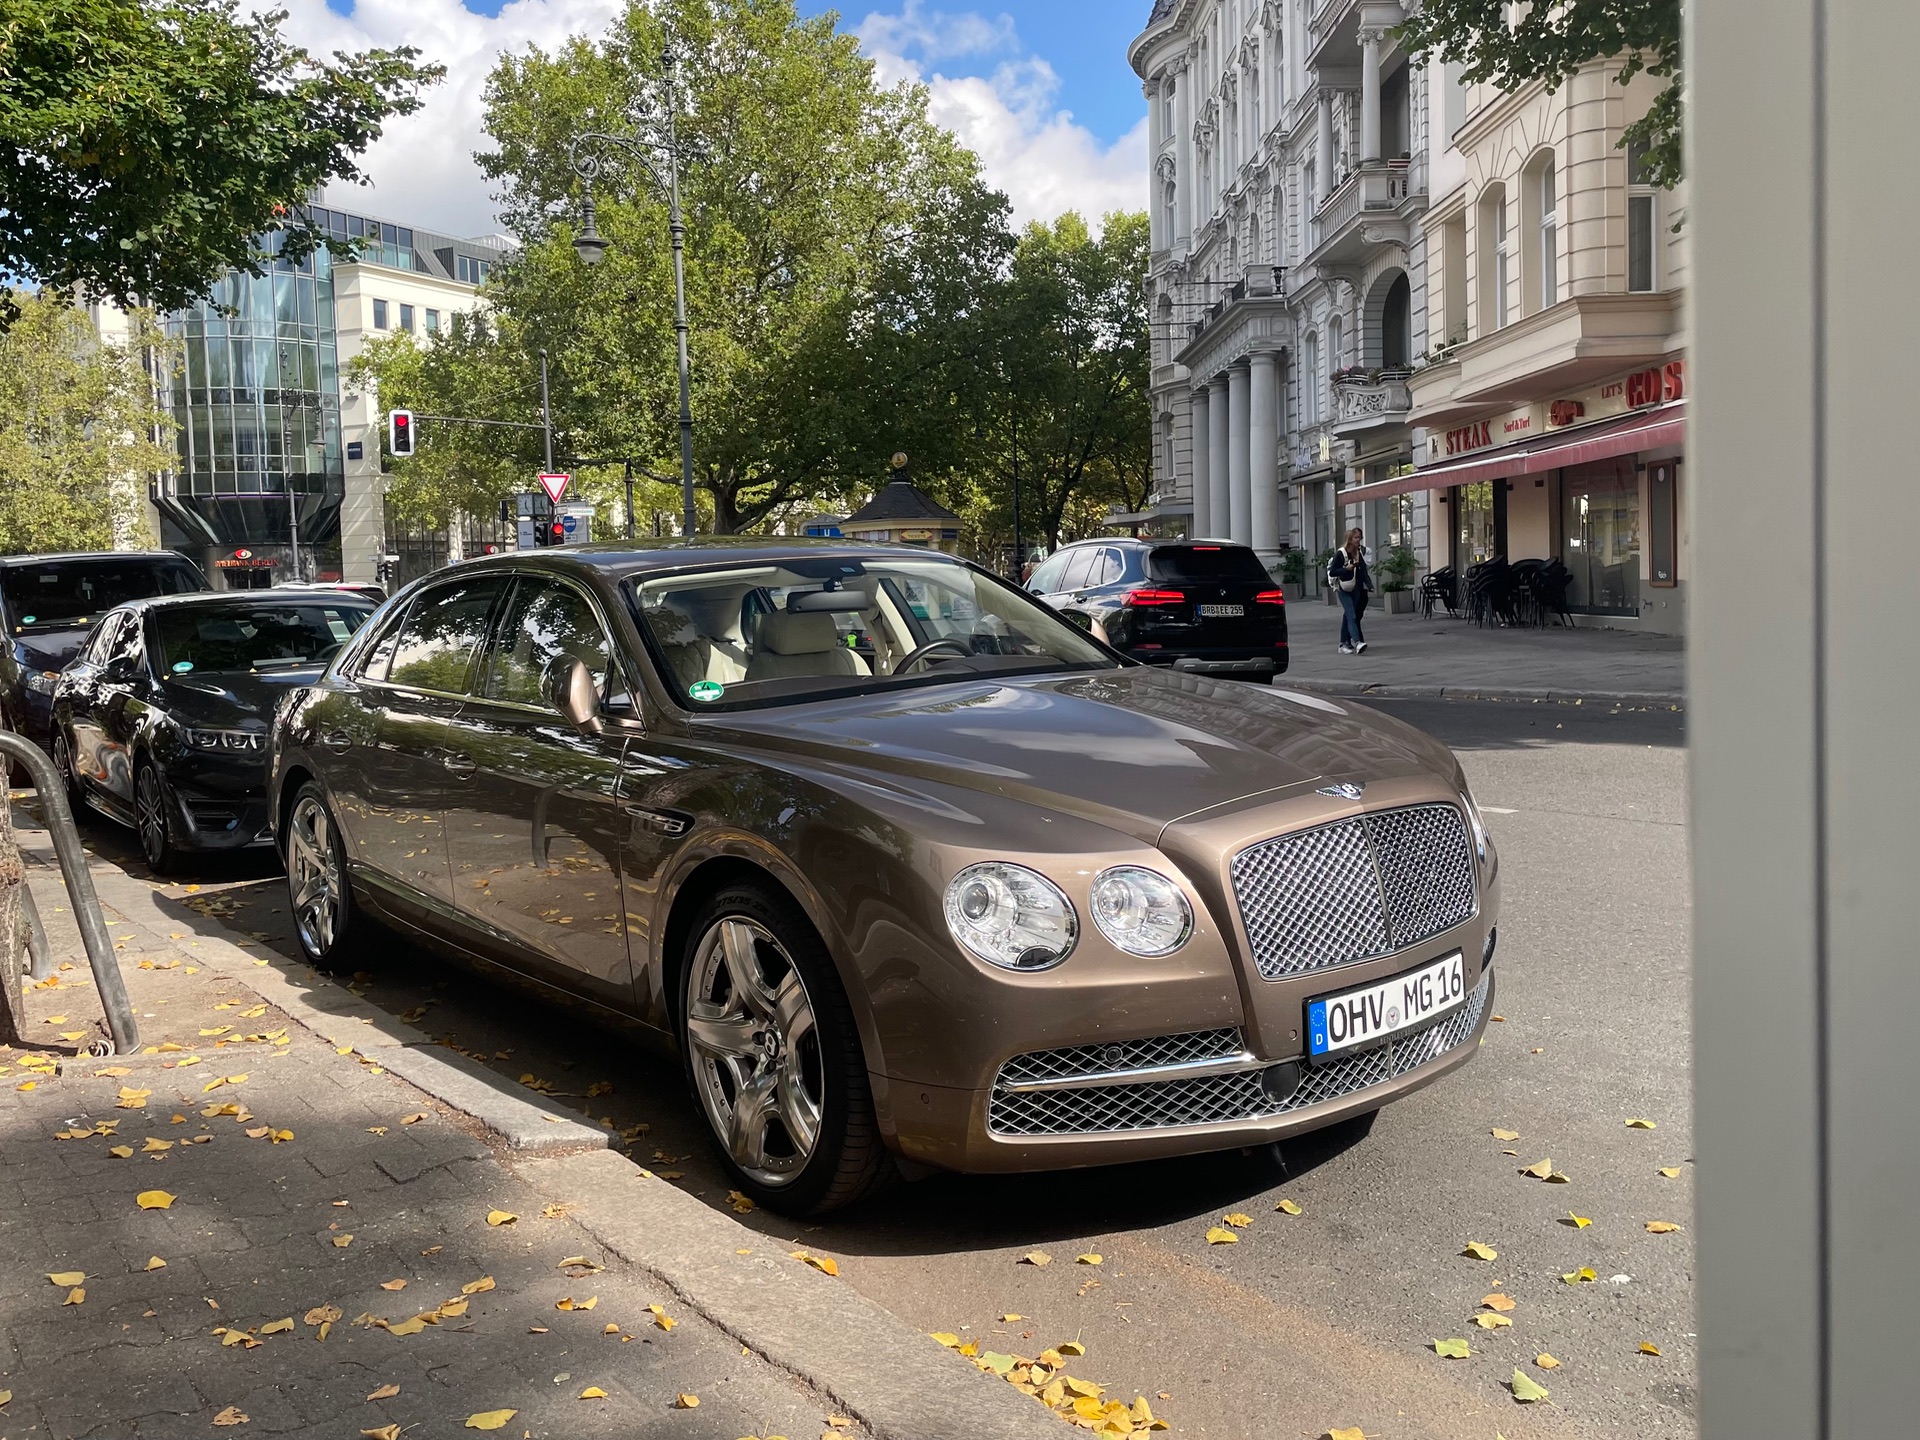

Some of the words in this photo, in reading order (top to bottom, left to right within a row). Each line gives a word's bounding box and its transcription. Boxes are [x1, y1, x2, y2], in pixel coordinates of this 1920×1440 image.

[1601, 382, 1623, 399] LET'S
[1446, 420, 1492, 455] STEAK
[252, 557, 280, 567] BERLIN
[1202, 606, 1215, 614] BRB
[1220, 606, 1229, 614] EE
[1230, 606, 1243, 614] 255
[1329, 991, 1384, 1042] OHV
[1404, 974, 1432, 1020] MG
[1438, 961, 1461, 1004] 16
[1316, 1033, 1323, 1045] D
